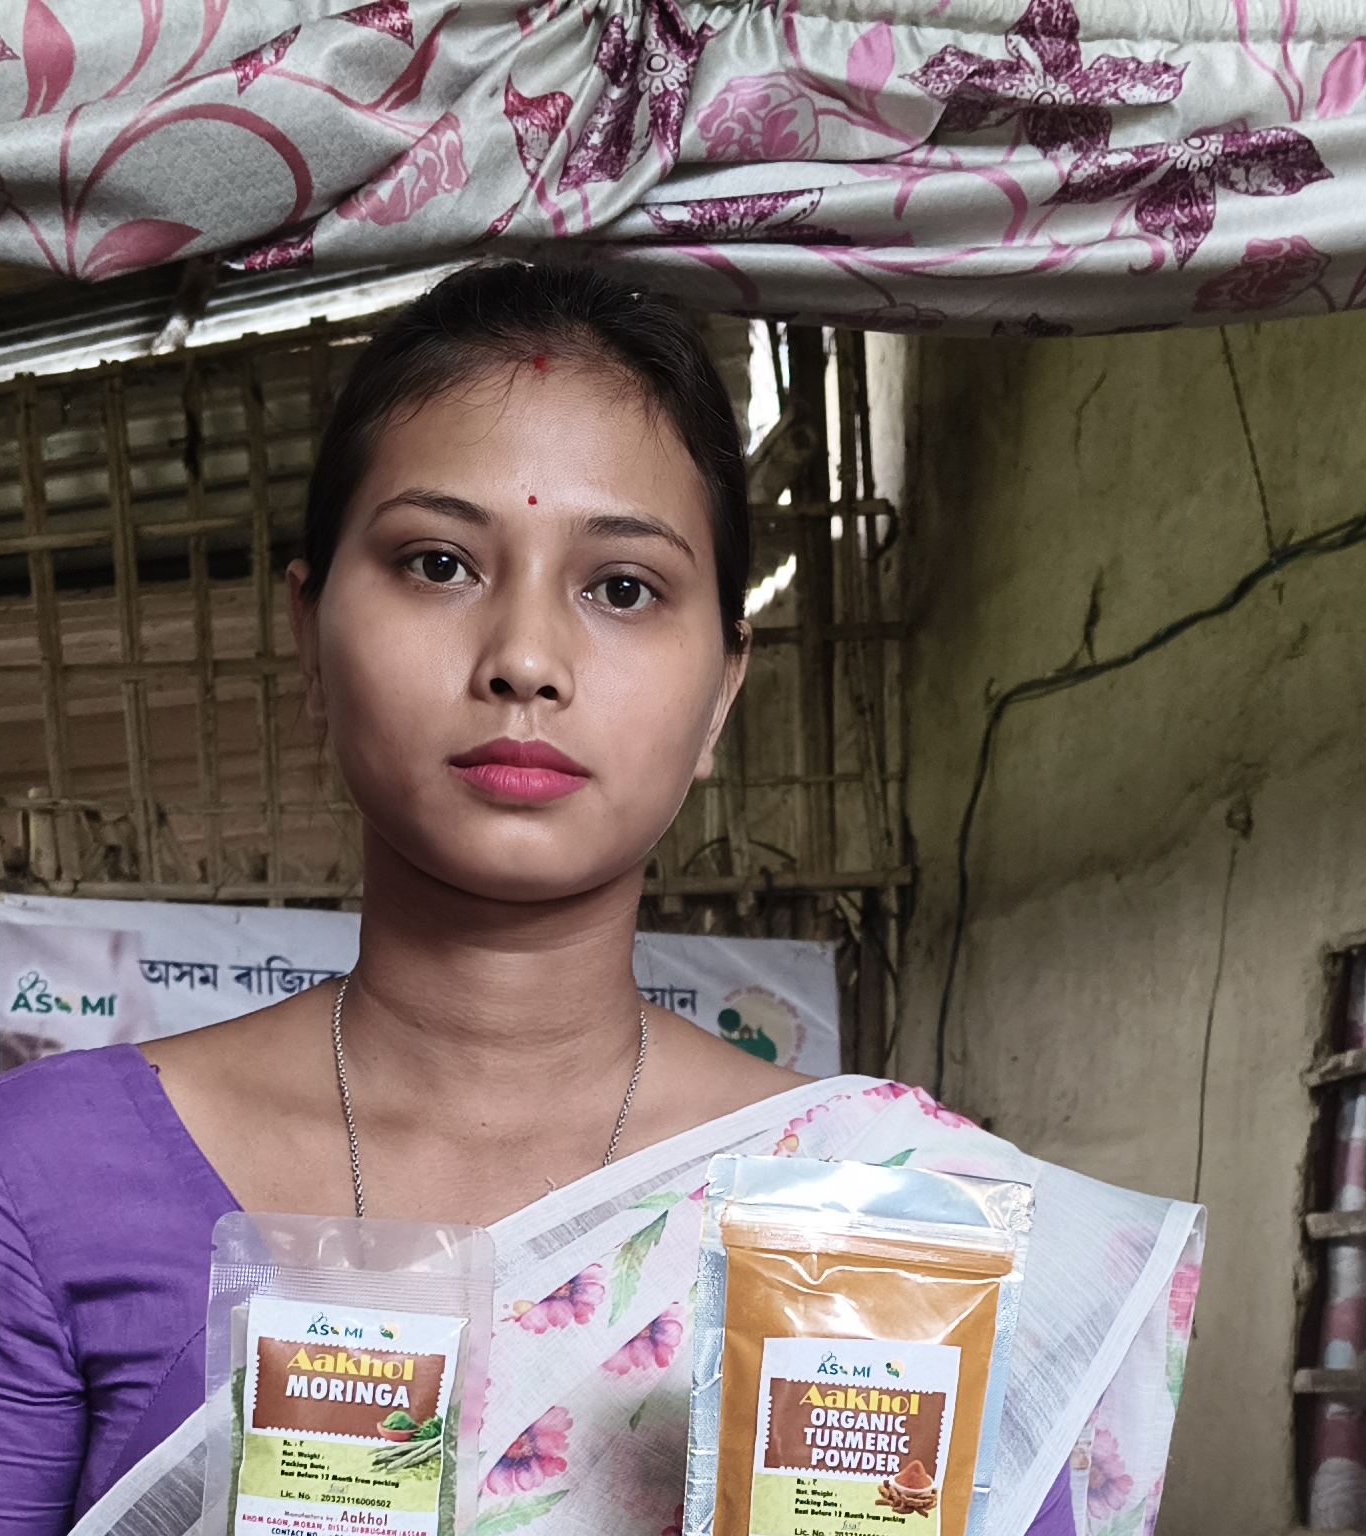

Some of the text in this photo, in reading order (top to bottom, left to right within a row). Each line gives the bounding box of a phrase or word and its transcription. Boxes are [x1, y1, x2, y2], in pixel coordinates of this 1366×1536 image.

[138, 959, 218, 990] অসম
[287, 1347, 415, 1381] Aakhol
[285, 1375, 410, 1409] MORINGA
[799, 1384, 920, 1415] Aakhol
[811, 1408, 908, 1434] ORGANIC
[804, 1428, 910, 1454] TURMERIC
[281, 1460, 307, 1469] Packing
[811, 1448, 900, 1473] POWDER
[297, 1471, 319, 1479] Before
[355, 1476, 371, 1485] from
[373, 1479, 399, 1488] packing
[795, 1498, 822, 1507] Packing
[340, 1510, 388, 1526] Aakhol
[810, 1508, 832, 1517] Before
[866, 1513, 881, 1521] from
[882, 1516, 906, 1524] packing
